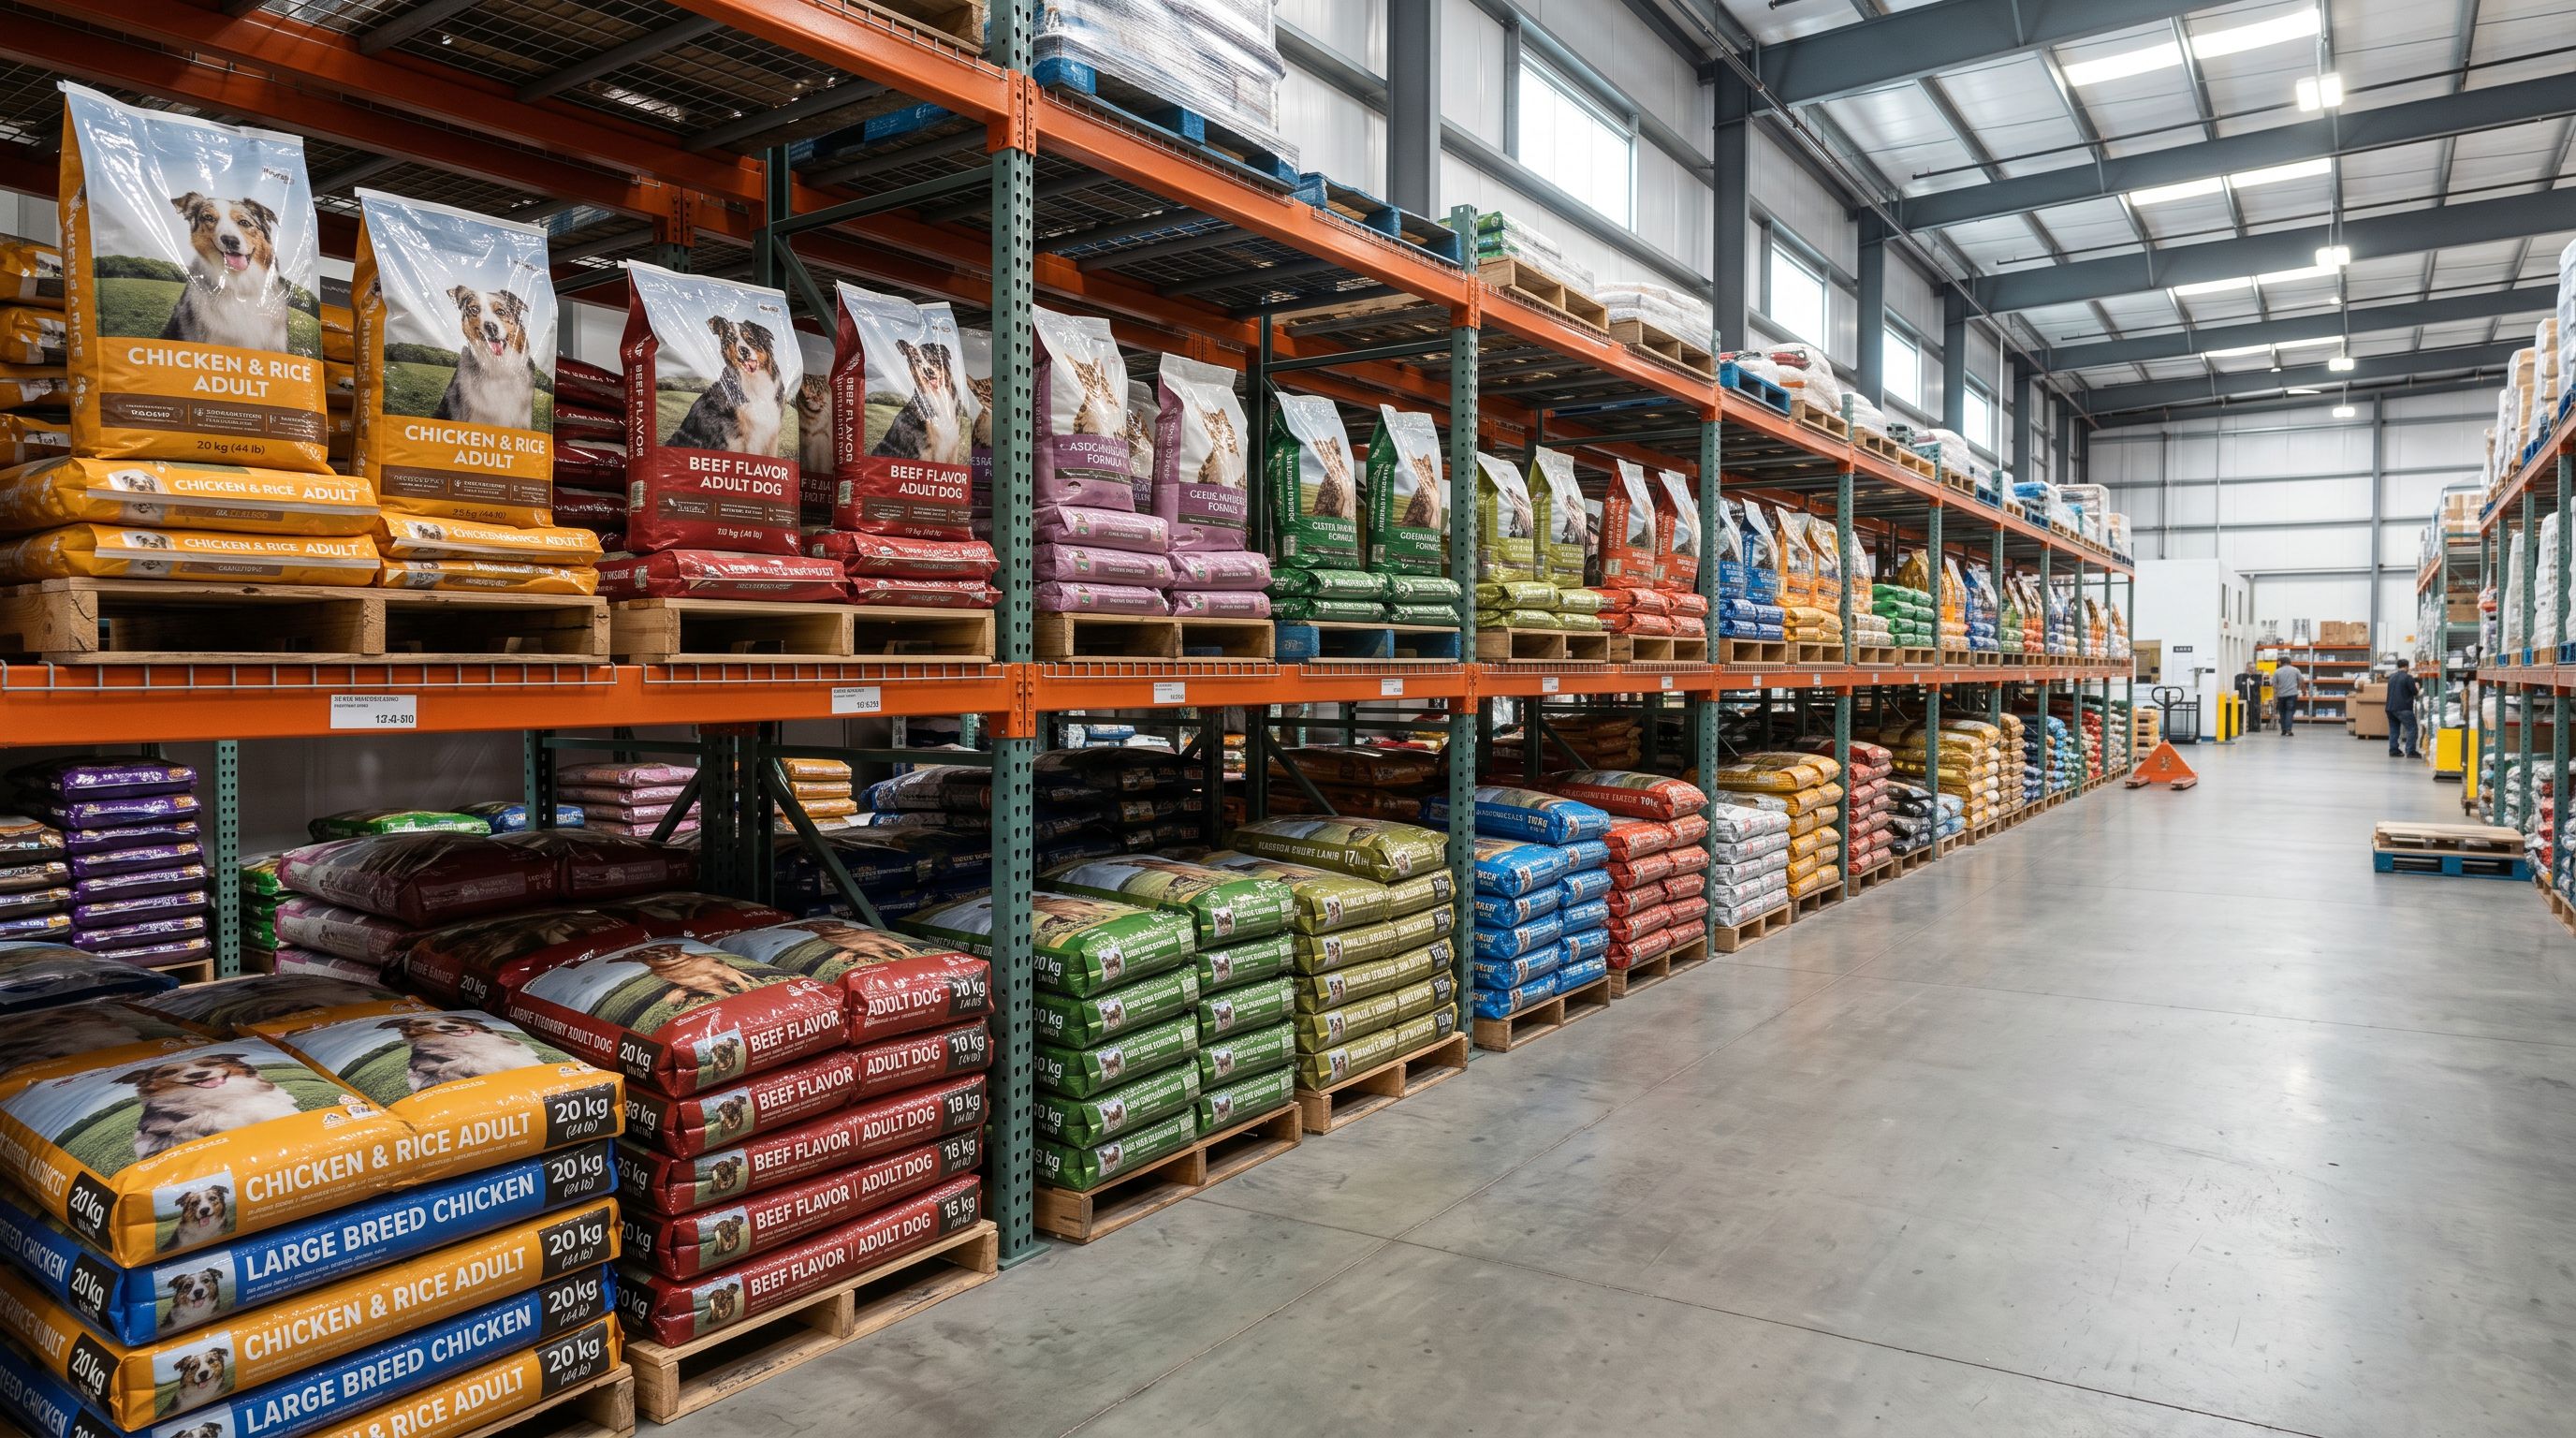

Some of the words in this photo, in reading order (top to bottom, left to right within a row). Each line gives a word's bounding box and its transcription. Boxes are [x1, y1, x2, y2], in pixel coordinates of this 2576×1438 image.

[127, 346, 242, 373] CHICKEN
[248, 359, 264, 376] &
[270, 361, 312, 383] RICE
[193, 374, 270, 398] ADULT
[197, 440, 212, 451] 20
[213, 440, 228, 453] kg
[230, 442, 248, 454] (44
[251, 444, 266, 455] lb)
[404, 425, 494, 448] CHICKEN
[500, 435, 512, 451] &
[515, 437, 545, 455] RICE
[453, 449, 515, 469] ADULT
[689, 457, 730, 473] BEEF
[736, 461, 788, 481] FLAVOR
[700, 476, 749, 492] ADULT
[753, 480, 783, 496] DOG
[890, 464, 923, 479] BEEF
[927, 468, 968, 485] FLAVOR
[174, 479, 247, 492] CHICKEN
[249, 483, 260, 493] &
[263, 485, 296, 496] RICE
[302, 487, 359, 502] ADULT
[899, 482, 936, 496] ADULT
[939, 487, 962, 498] DOG
[183, 538, 252, 551] CHICKEN
[253, 542, 265, 552] &
[268, 543, 300, 552] RICE
[305, 543, 359, 556] ADULT
[1048, 957, 1061, 976] kg
[461, 976, 476, 990] 20
[475, 979, 487, 999] kg
[972, 977, 986, 997] kg
[867, 993, 909, 1017] ADULT
[912, 988, 942, 1007] DOG
[750, 1026, 784, 1052] BEEF
[786, 1009, 841, 1041] FLAVOR
[1048, 1009, 1063, 1030] kg
[567, 1026, 593, 1049] ADULT
[593, 1035, 612, 1053] DOG
[970, 1034, 985, 1050] kg
[620, 1043, 635, 1065] 20
[637, 1047, 651, 1072] kg
[867, 1050, 908, 1077] ADULT
[912, 1044, 940, 1065] DOG
[1048, 1058, 1061, 1078] kg
[757, 1084, 795, 1110] BEEF
[798, 1065, 854, 1098] FLAVOR
[966, 1093, 979, 1110] kg
[554, 1099, 580, 1123] 20
[585, 1095, 608, 1120] kg
[640, 1105, 657, 1131] kg
[1048, 1107, 1061, 1127] kg
[754, 1146, 792, 1172] BEEF
[795, 1131, 850, 1161] FLAVOR
[863, 1114, 904, 1142] ADULT
[907, 1105, 936, 1127] DOG
[960, 1138, 975, 1155] kg
[245, 1150, 365, 1202] CHICKEN
[372, 1144, 389, 1168] &
[395, 1128, 451, 1163] RICE
[458, 1111, 532, 1150] ADULT
[551, 1159, 577, 1183] 20
[580, 1153, 603, 1176] kg
[1045, 1150, 1060, 1172] kg
[633, 1163, 648, 1191] kg
[755, 1203, 792, 1230] BEEF
[796, 1184, 850, 1217] FLAVOR
[861, 1165, 902, 1195] ADULT
[906, 1153, 932, 1178] DOG
[70, 1186, 90, 1213] 20
[86, 1193, 105, 1229] kg
[944, 1200, 959, 1219] 15
[960, 1195, 975, 1212] kg
[245, 1231, 337, 1282] LARGE
[343, 1206, 427, 1252] BREED
[432, 1172, 534, 1223] CHICKEN
[549, 1229, 576, 1256] 20
[580, 1223, 603, 1245] kg
[637, 1225, 651, 1253] kg
[22, 1236, 67, 1283] CHICKEN
[751, 1268, 788, 1297] BEEF
[792, 1247, 845, 1281] FLAVOR
[857, 1225, 900, 1255] ADULT
[903, 1211, 931, 1233] DOG
[71, 1268, 90, 1296] 20
[88, 1275, 105, 1311] kg
[549, 1286, 575, 1314] 20
[576, 1277, 597, 1302] kg
[245, 1300, 361, 1361] CHICKEN
[369, 1294, 388, 1318] &
[392, 1273, 448, 1312] RICE
[454, 1247, 526, 1292] ADULT
[632, 1292, 648, 1320] kg
[245, 1379, 336, 1434] LARGE
[343, 1348, 424, 1399] BREED
[431, 1304, 532, 1363] CHICKEN
[549, 1346, 575, 1373] 20
[578, 1337, 600, 1359] kg
[71, 1347, 90, 1377] 20
[88, 1357, 106, 1395] kg
[22, 1387, 67, 1438] CHICKEN
[389, 1398, 447, 1438] RICE
[454, 1366, 524, 1416] ADULT
